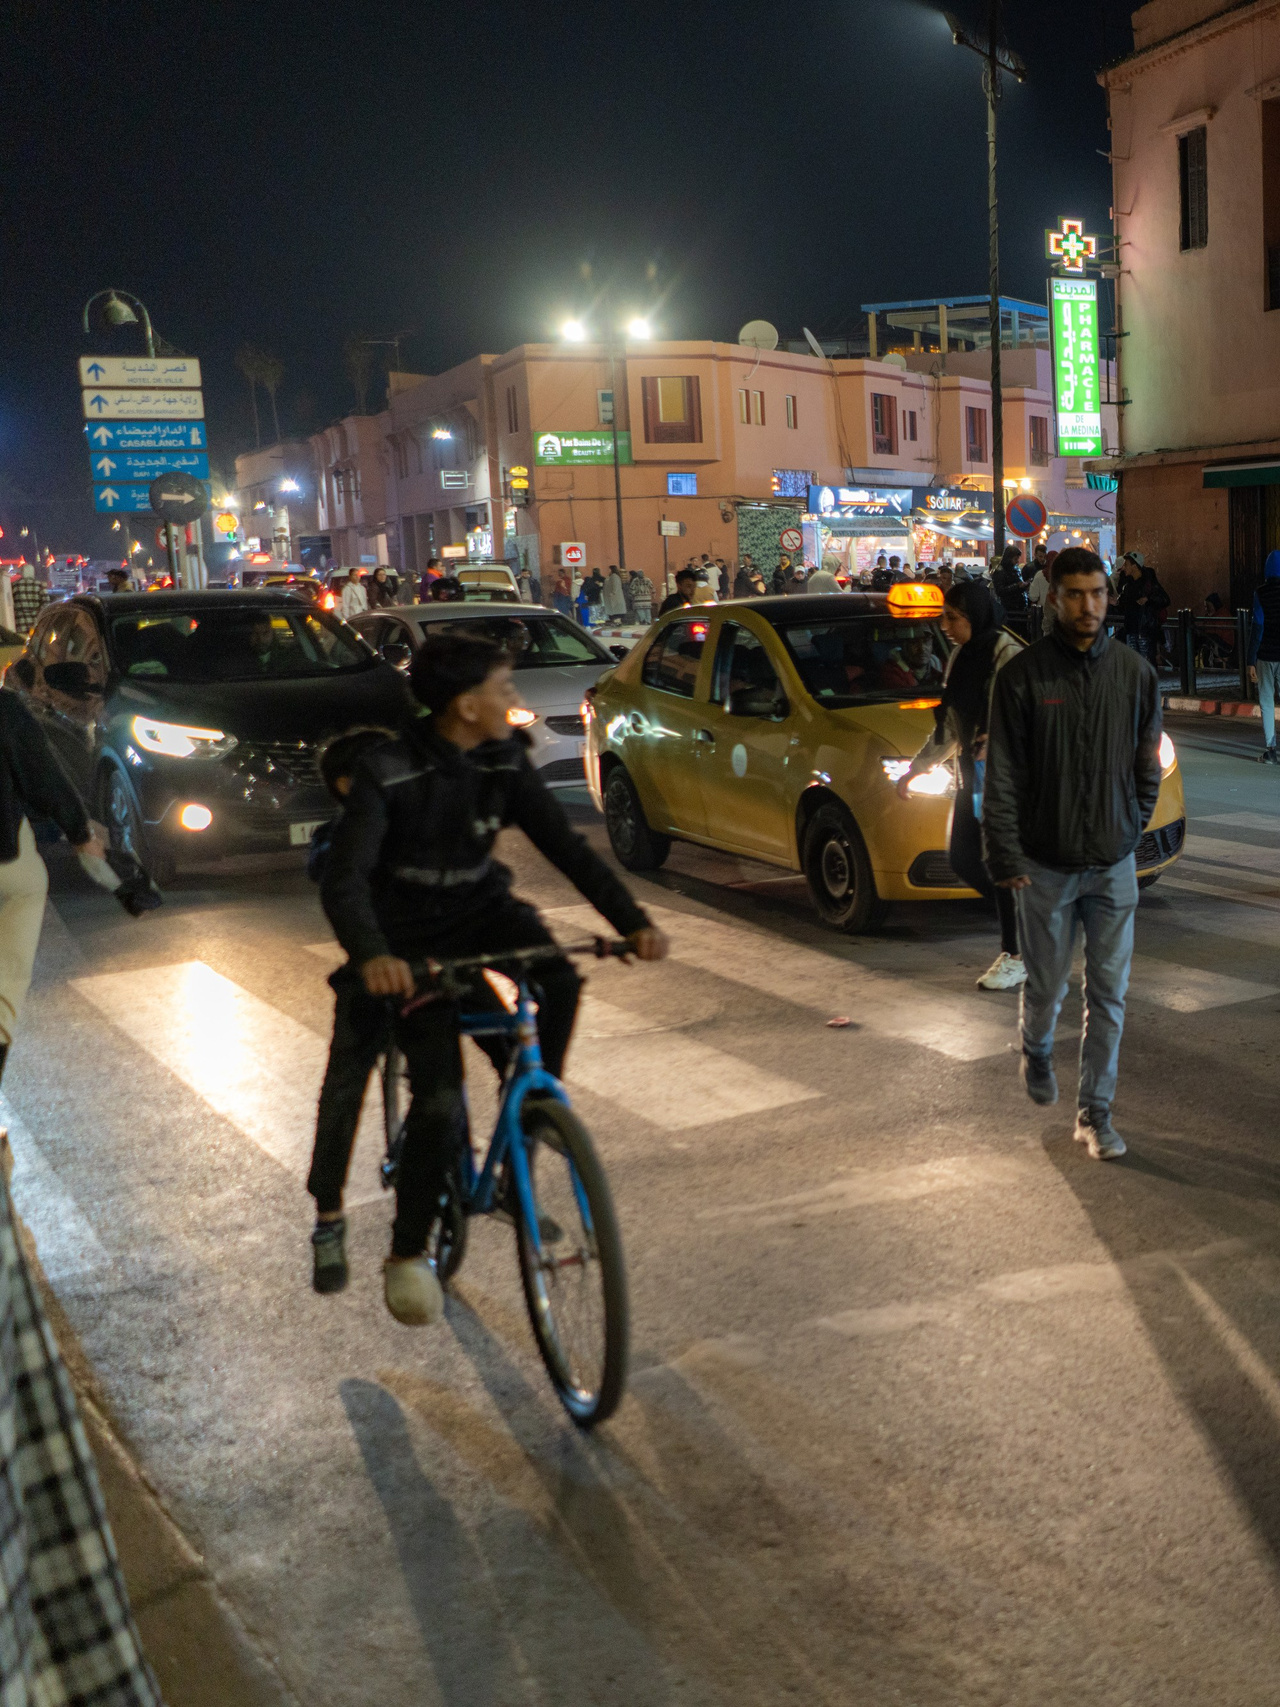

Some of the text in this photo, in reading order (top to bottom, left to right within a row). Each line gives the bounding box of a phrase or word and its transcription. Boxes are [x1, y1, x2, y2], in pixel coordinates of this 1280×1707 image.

[1054, 281, 1095, 298] المدينة
[1061, 302, 1078, 411] صيدلية
[1079, 302, 1096, 412] PHARMACIE
[1075, 414, 1084, 423] DE
[1060, 425, 1100, 435] LA MEDINA
[120, 439, 185, 448] CASABLANCA
[567, 550, 582, 559] قف
